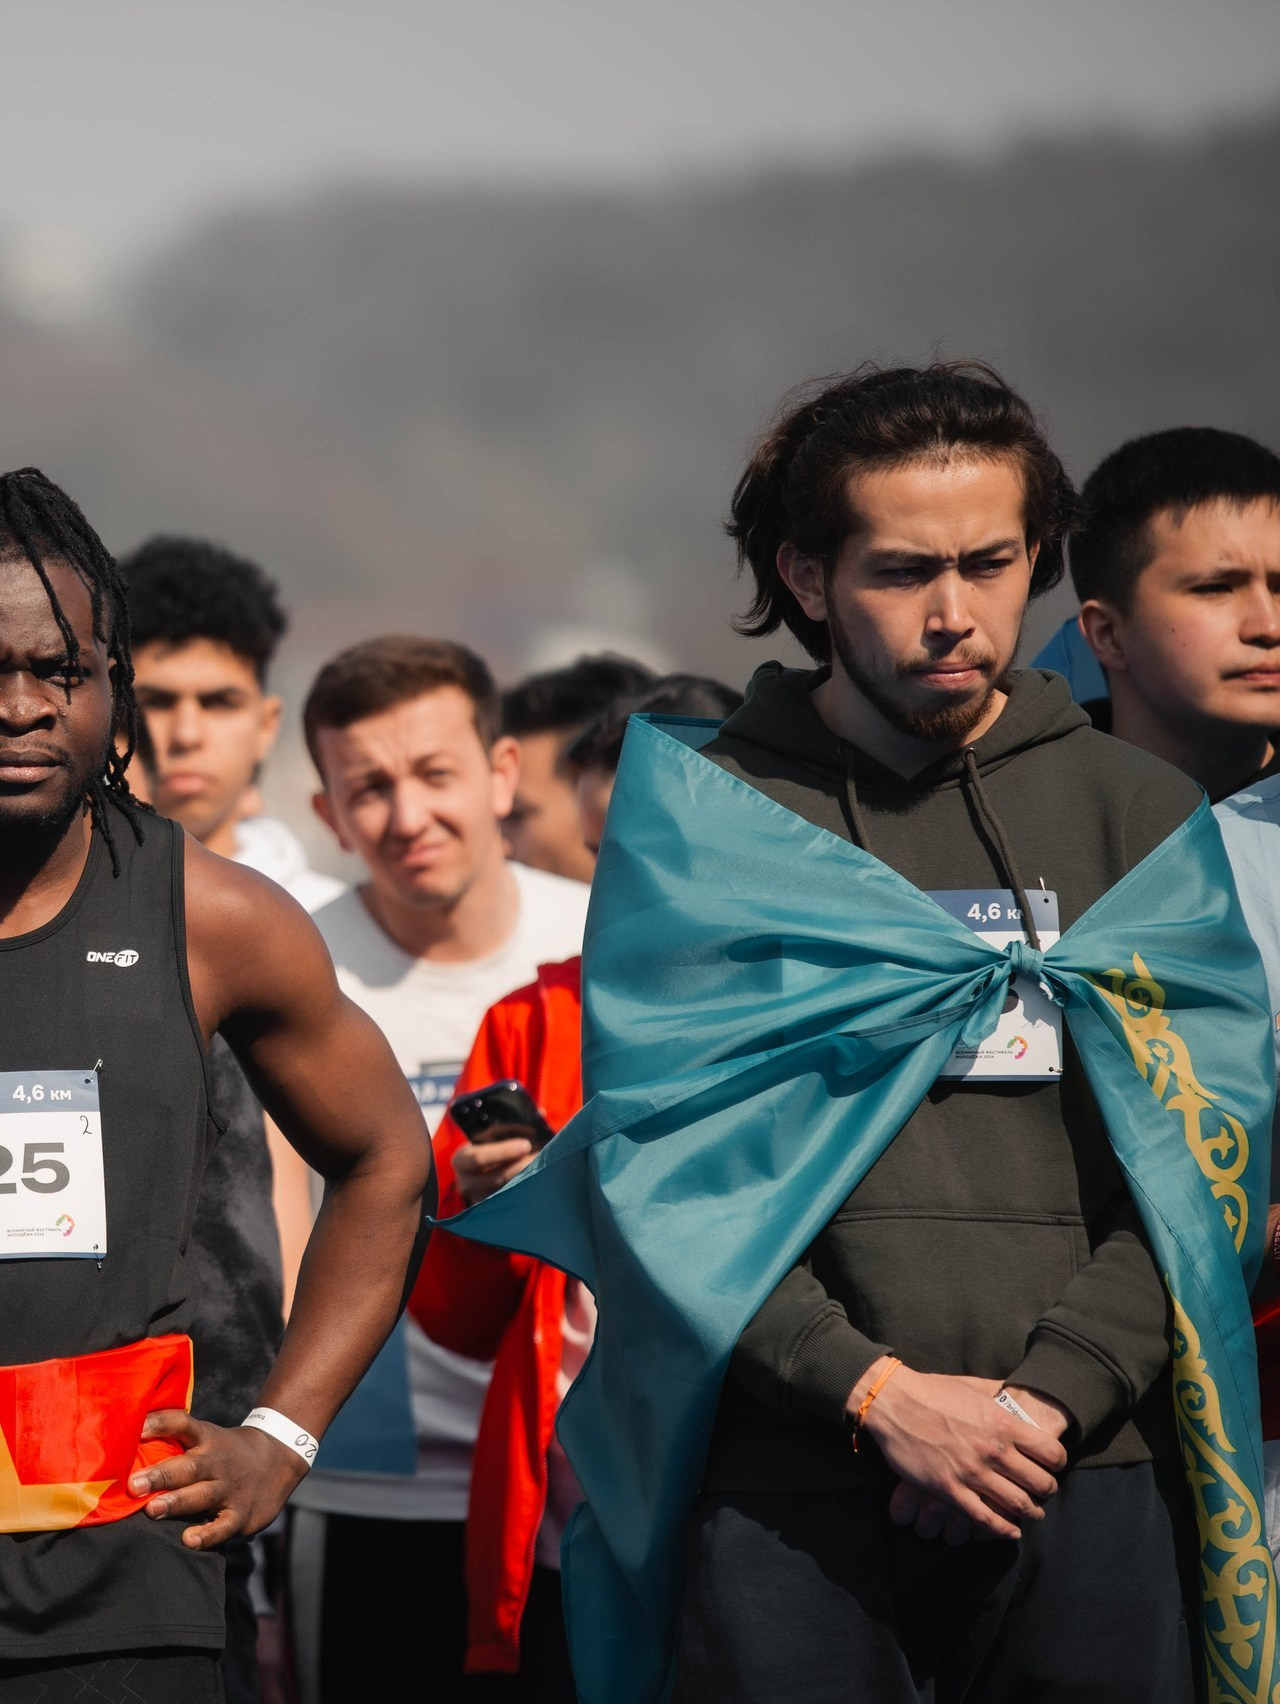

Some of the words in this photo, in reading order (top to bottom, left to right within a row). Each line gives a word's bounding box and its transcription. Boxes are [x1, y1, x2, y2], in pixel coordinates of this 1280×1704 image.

[967, 902, 1001, 923] 4,6
[12, 1084, 45, 1104] 4,6
[80, 1115, 93, 1135] 2
